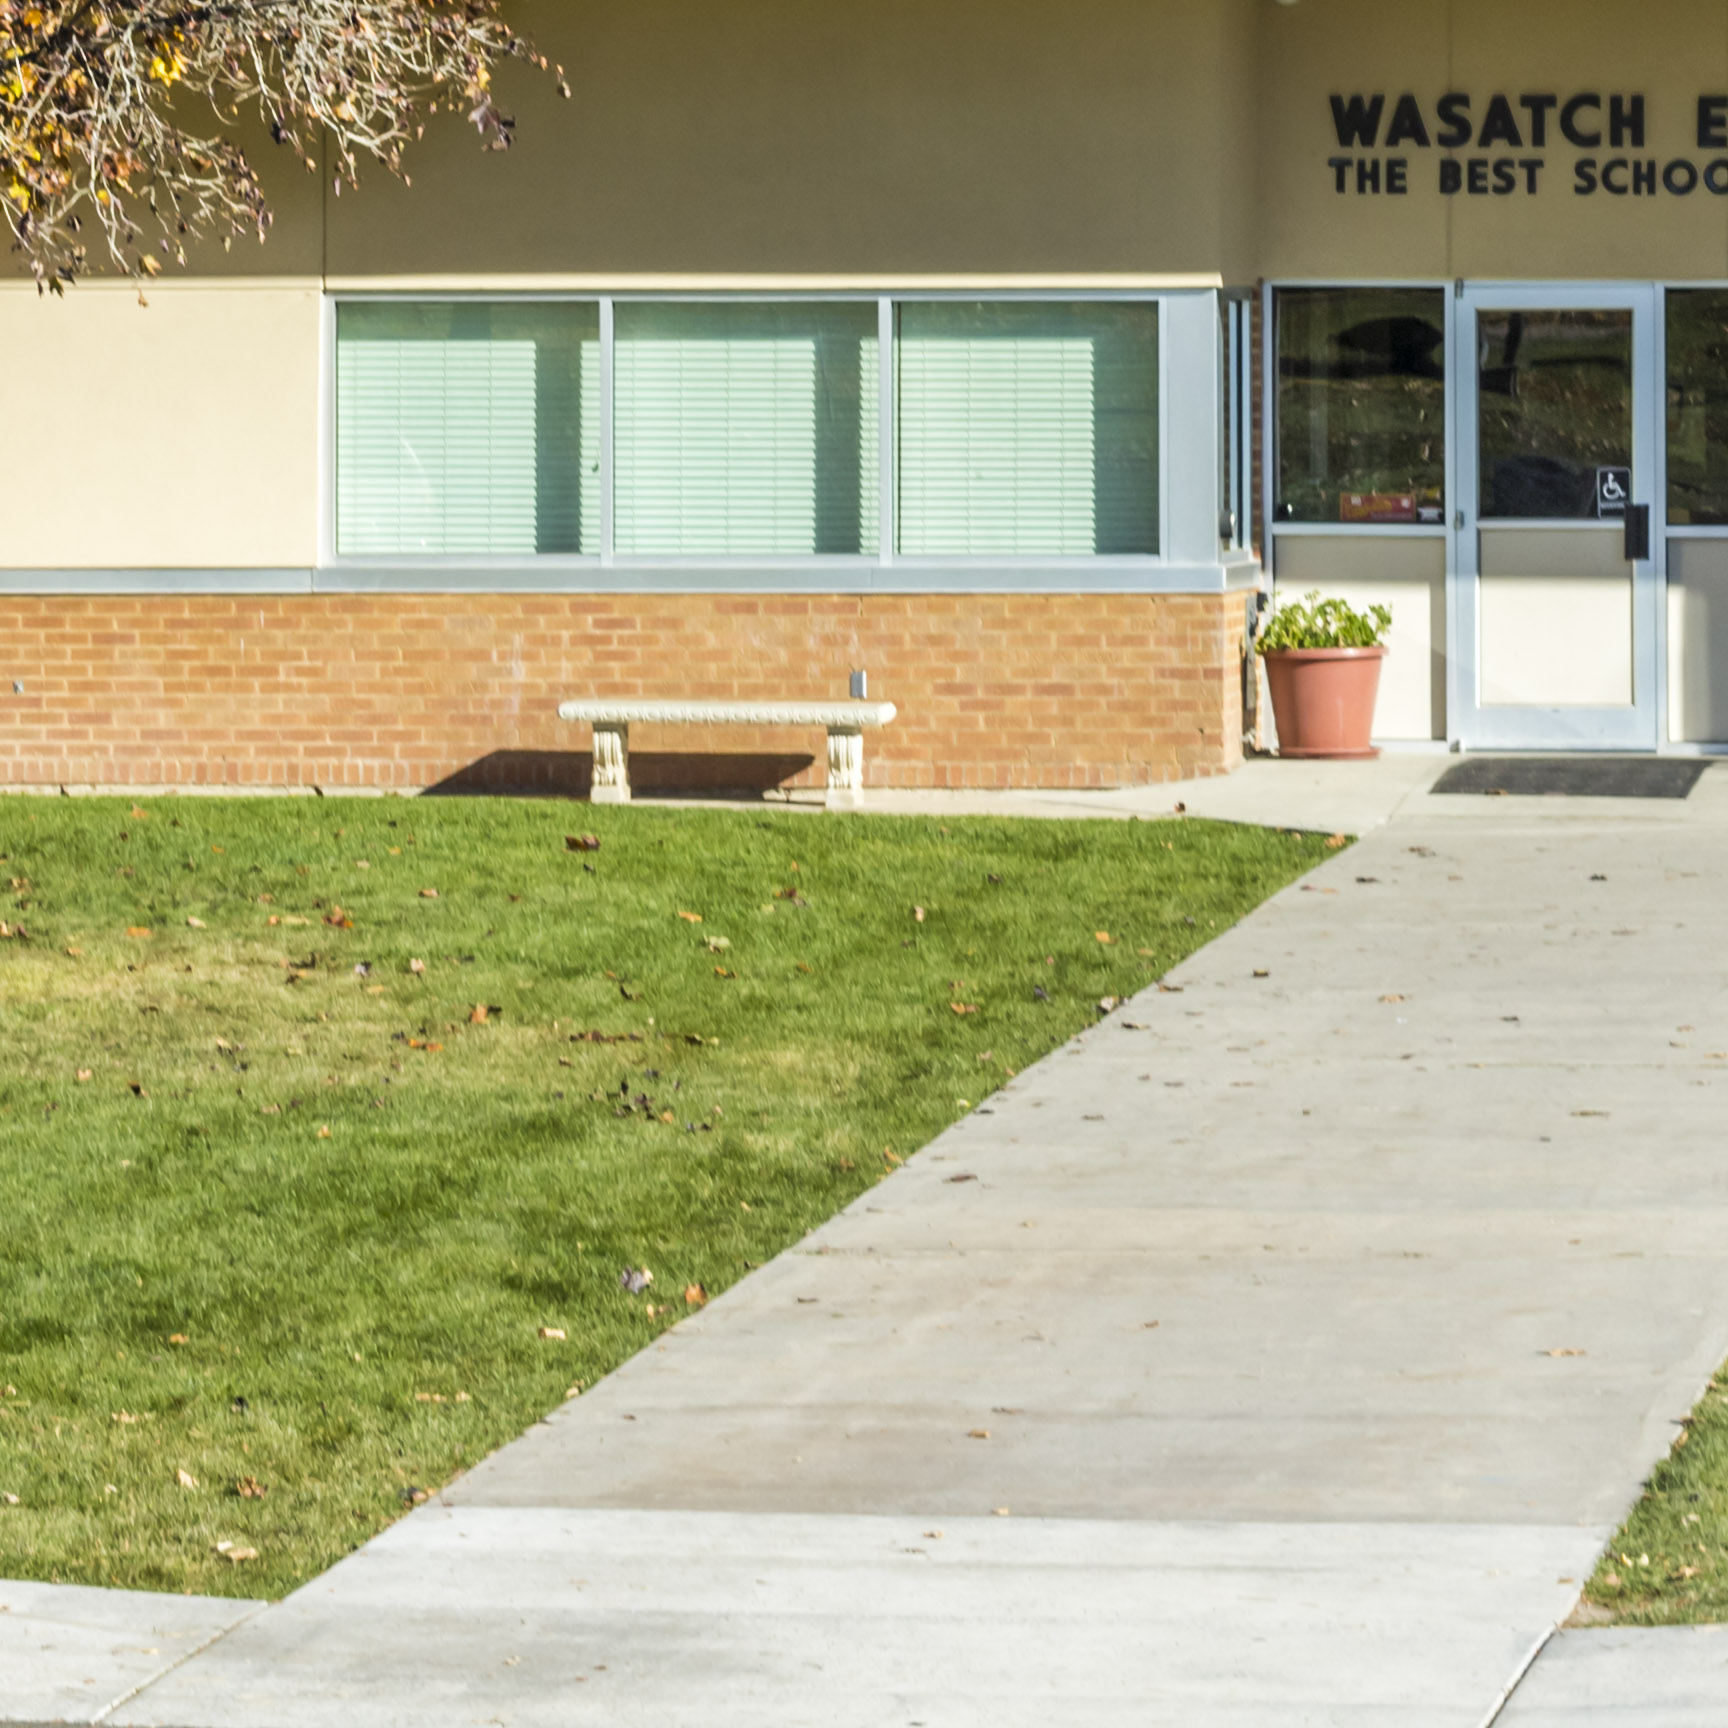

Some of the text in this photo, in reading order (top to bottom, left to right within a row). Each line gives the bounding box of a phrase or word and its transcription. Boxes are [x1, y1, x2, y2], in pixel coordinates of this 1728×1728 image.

[1328, 92, 1646, 149] WASATCH
[1327, 157, 1408, 195] THE
[1439, 157, 1544, 195] BEST
